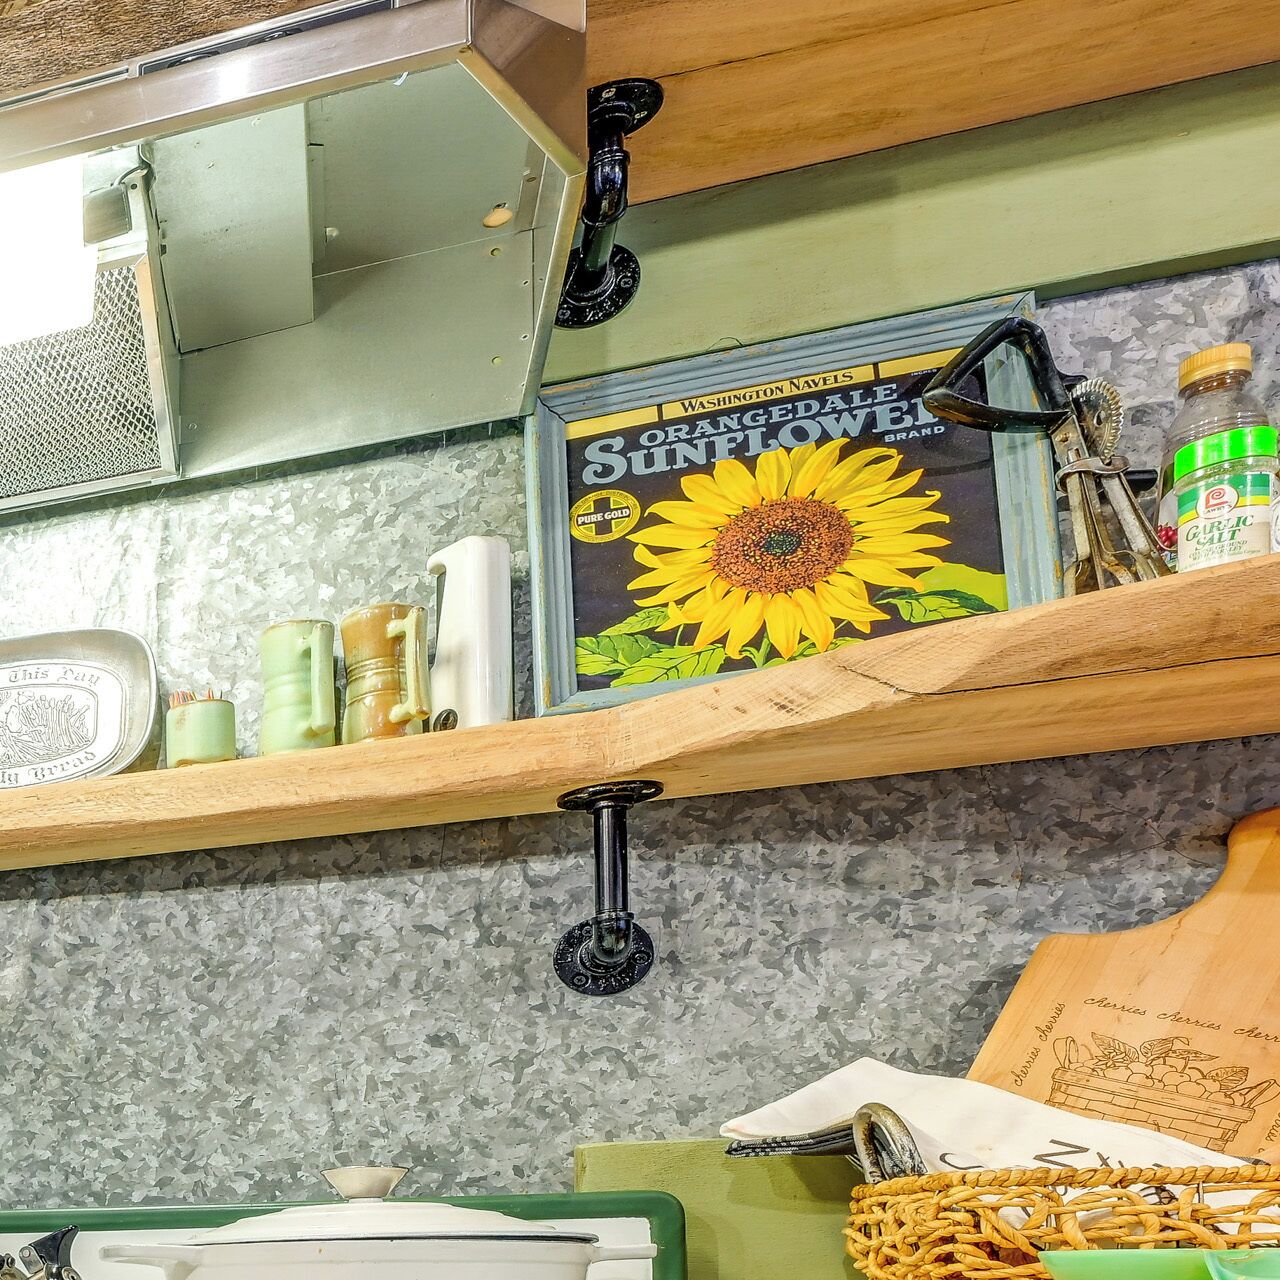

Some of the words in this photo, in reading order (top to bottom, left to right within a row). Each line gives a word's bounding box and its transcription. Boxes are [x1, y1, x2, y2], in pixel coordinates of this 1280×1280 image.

[680, 385, 784, 413] WASHINGTON
[789, 371, 853, 392] NAVELS
[639, 383, 898, 446] ORANGEDALE
[884, 425, 945, 443] BRAND
[577, 513, 604, 525] PURE
[604, 508, 630, 520] GOLD
[1185, 514, 1254, 542] GARLIC
[8, 665, 49, 684] This
[1083, 996, 1147, 1017] cherries
[1156, 1010, 1222, 1032] cherries
[1010, 1046, 1041, 1087] cherries
[1035, 1002, 1066, 1042] cherries
